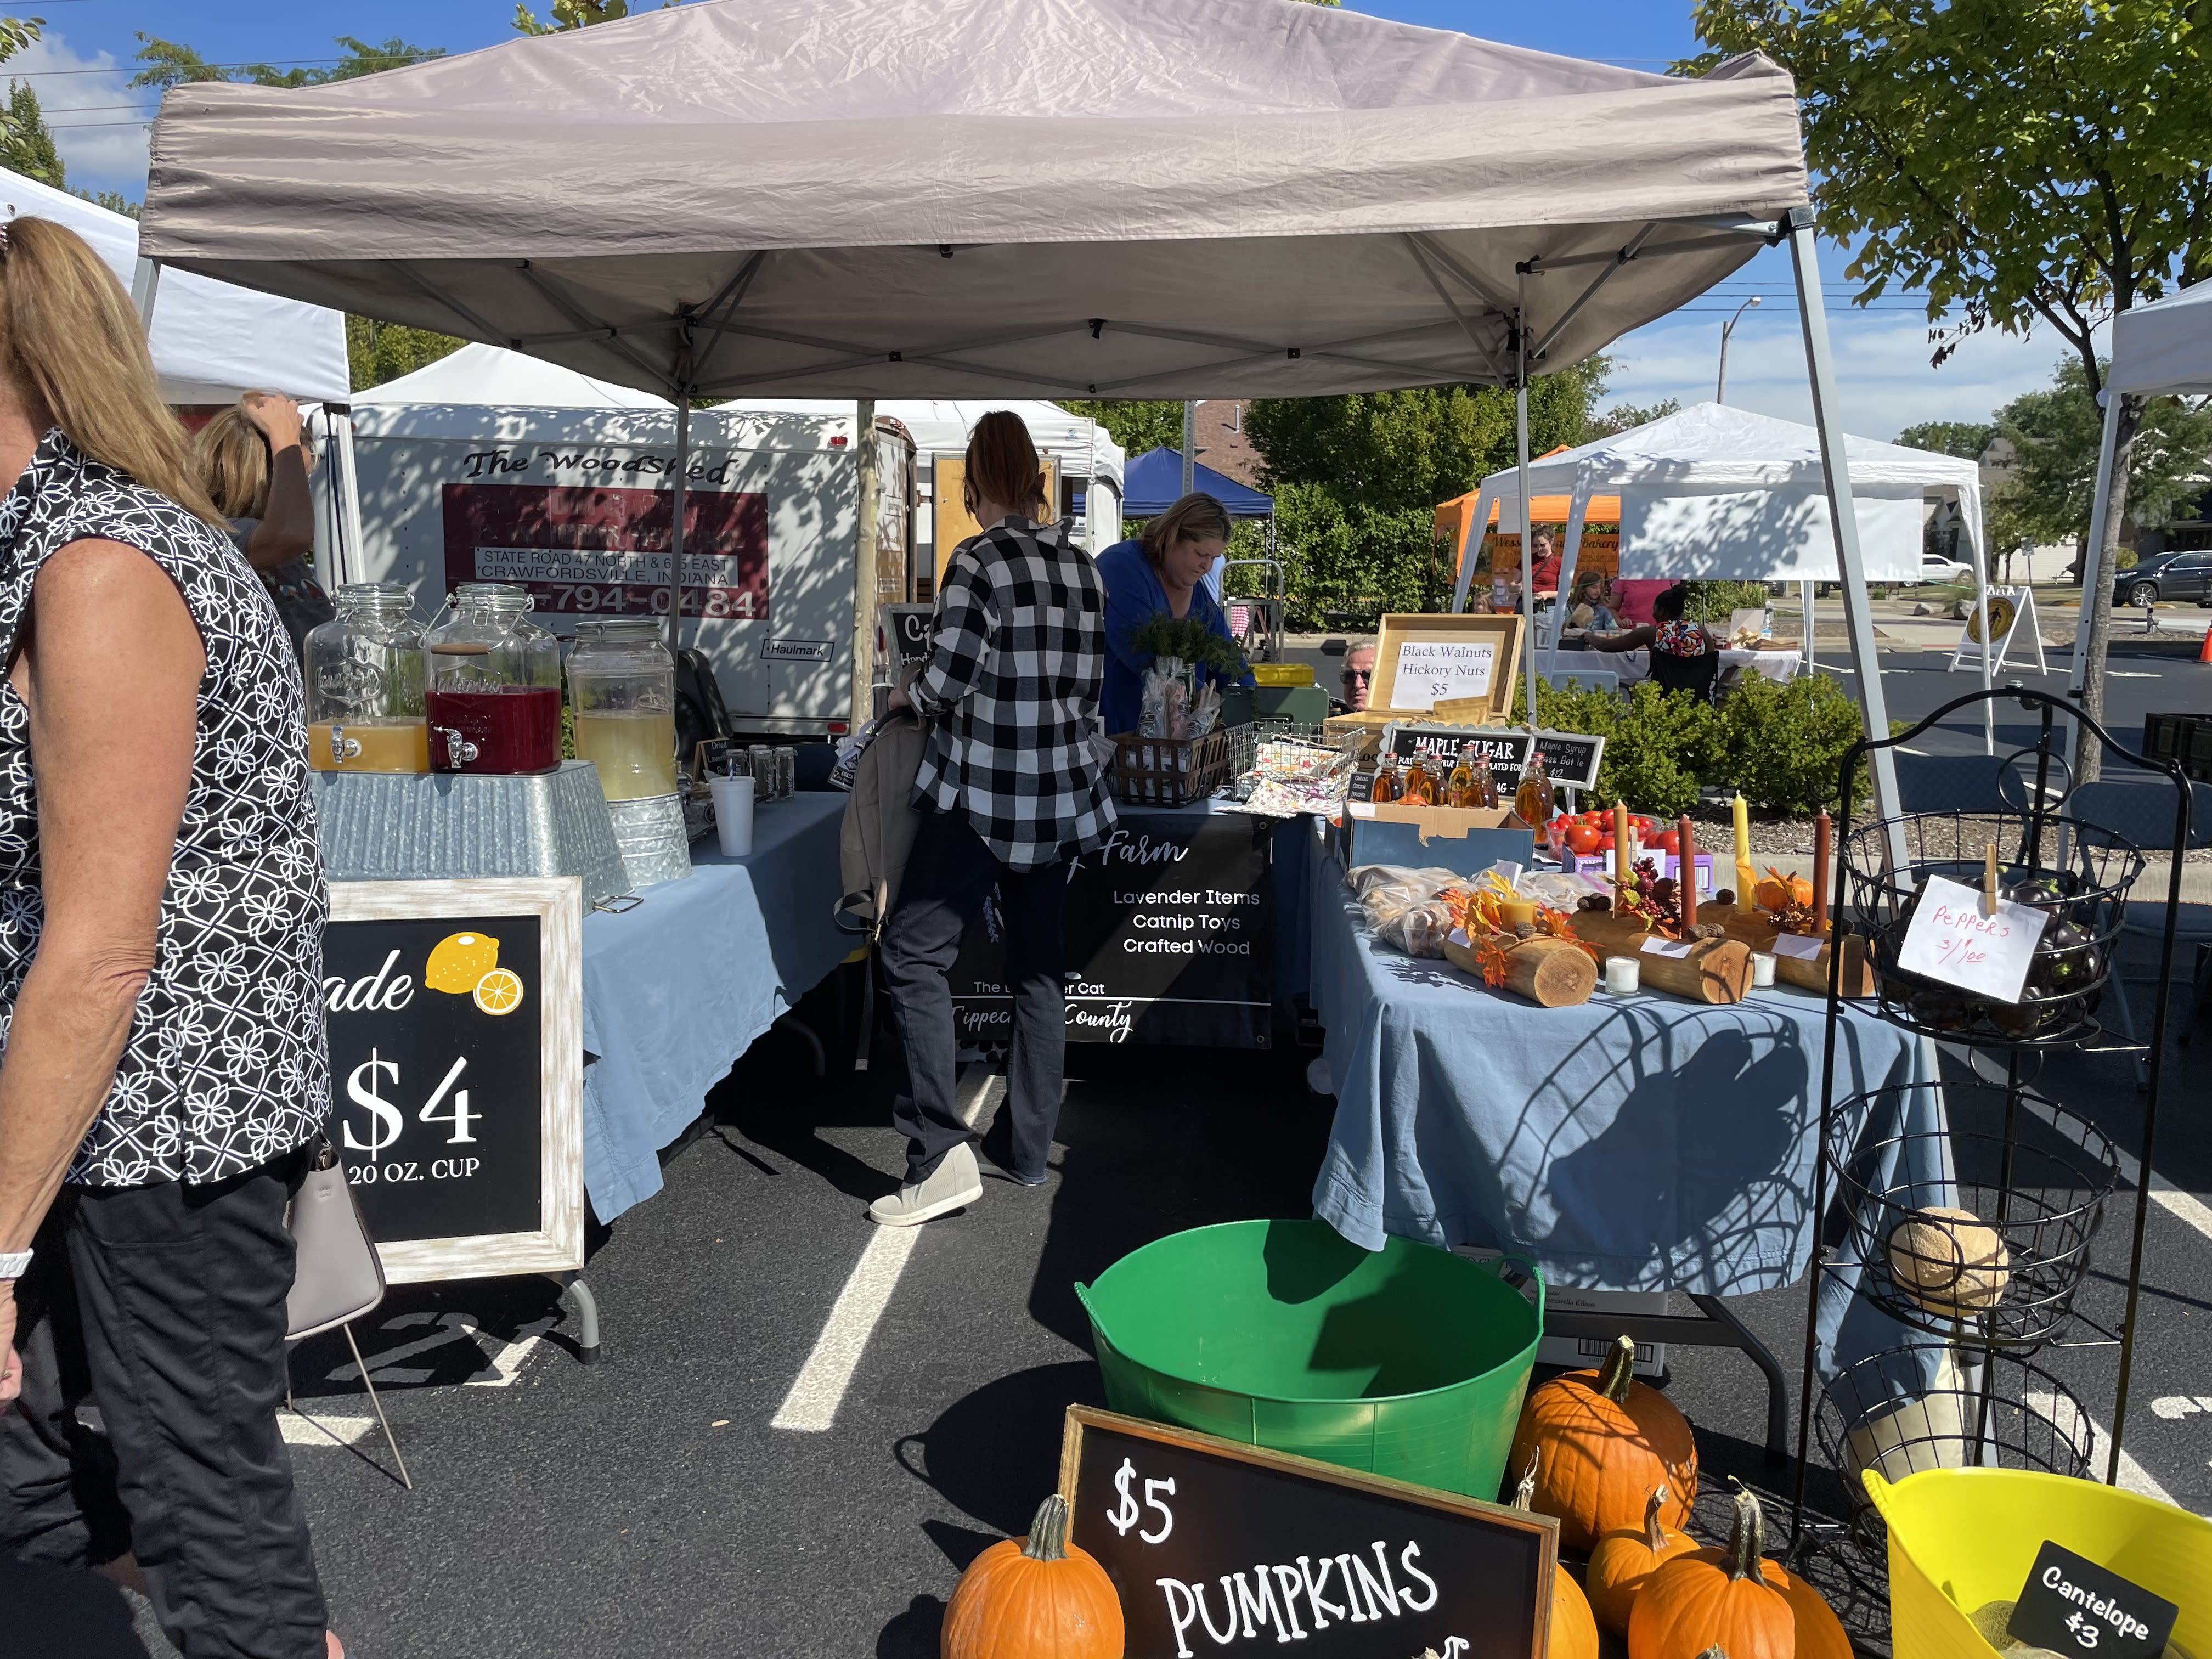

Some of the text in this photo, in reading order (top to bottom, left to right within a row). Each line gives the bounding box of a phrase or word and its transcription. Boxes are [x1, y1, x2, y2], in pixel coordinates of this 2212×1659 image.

[464, 450, 528, 479] The
[484, 551, 729, 572] STATE ROAD 47 NORTH & 65 EAST
[481, 566, 728, 586] CRAWFORDSVILLE, INDIANA
[771, 644, 825, 657] Haulmark
[1402, 645, 1492, 658] Black Walnuts
[1402, 663, 1485, 678] Hickory Nuts
[1431, 682, 1448, 696] $5
[712, 741, 727, 751] Dried
[1413, 736, 1514, 759] MAPLE UGAR
[1539, 741, 1587, 757] Maple Syrup
[1441, 759, 1455, 768] RUP
[1550, 768, 1564, 778] $12
[1097, 830, 1189, 866] Farm
[1113, 889, 1260, 905] Lavender Items
[1133, 914, 1241, 932] Catnip Toys
[1123, 937, 1250, 955] Crafted Wood
[973, 981, 1001, 993] The
[1077, 982, 1105, 994] Cat
[348, 1157, 480, 1184] 20 OZ. CUP
[1106, 1457, 1176, 1544] $5
[1155, 1540, 1438, 1659] PUMPKINS
[2042, 1566, 2149, 1641] Cantelope
[2064, 1611, 2100, 1649] $3
